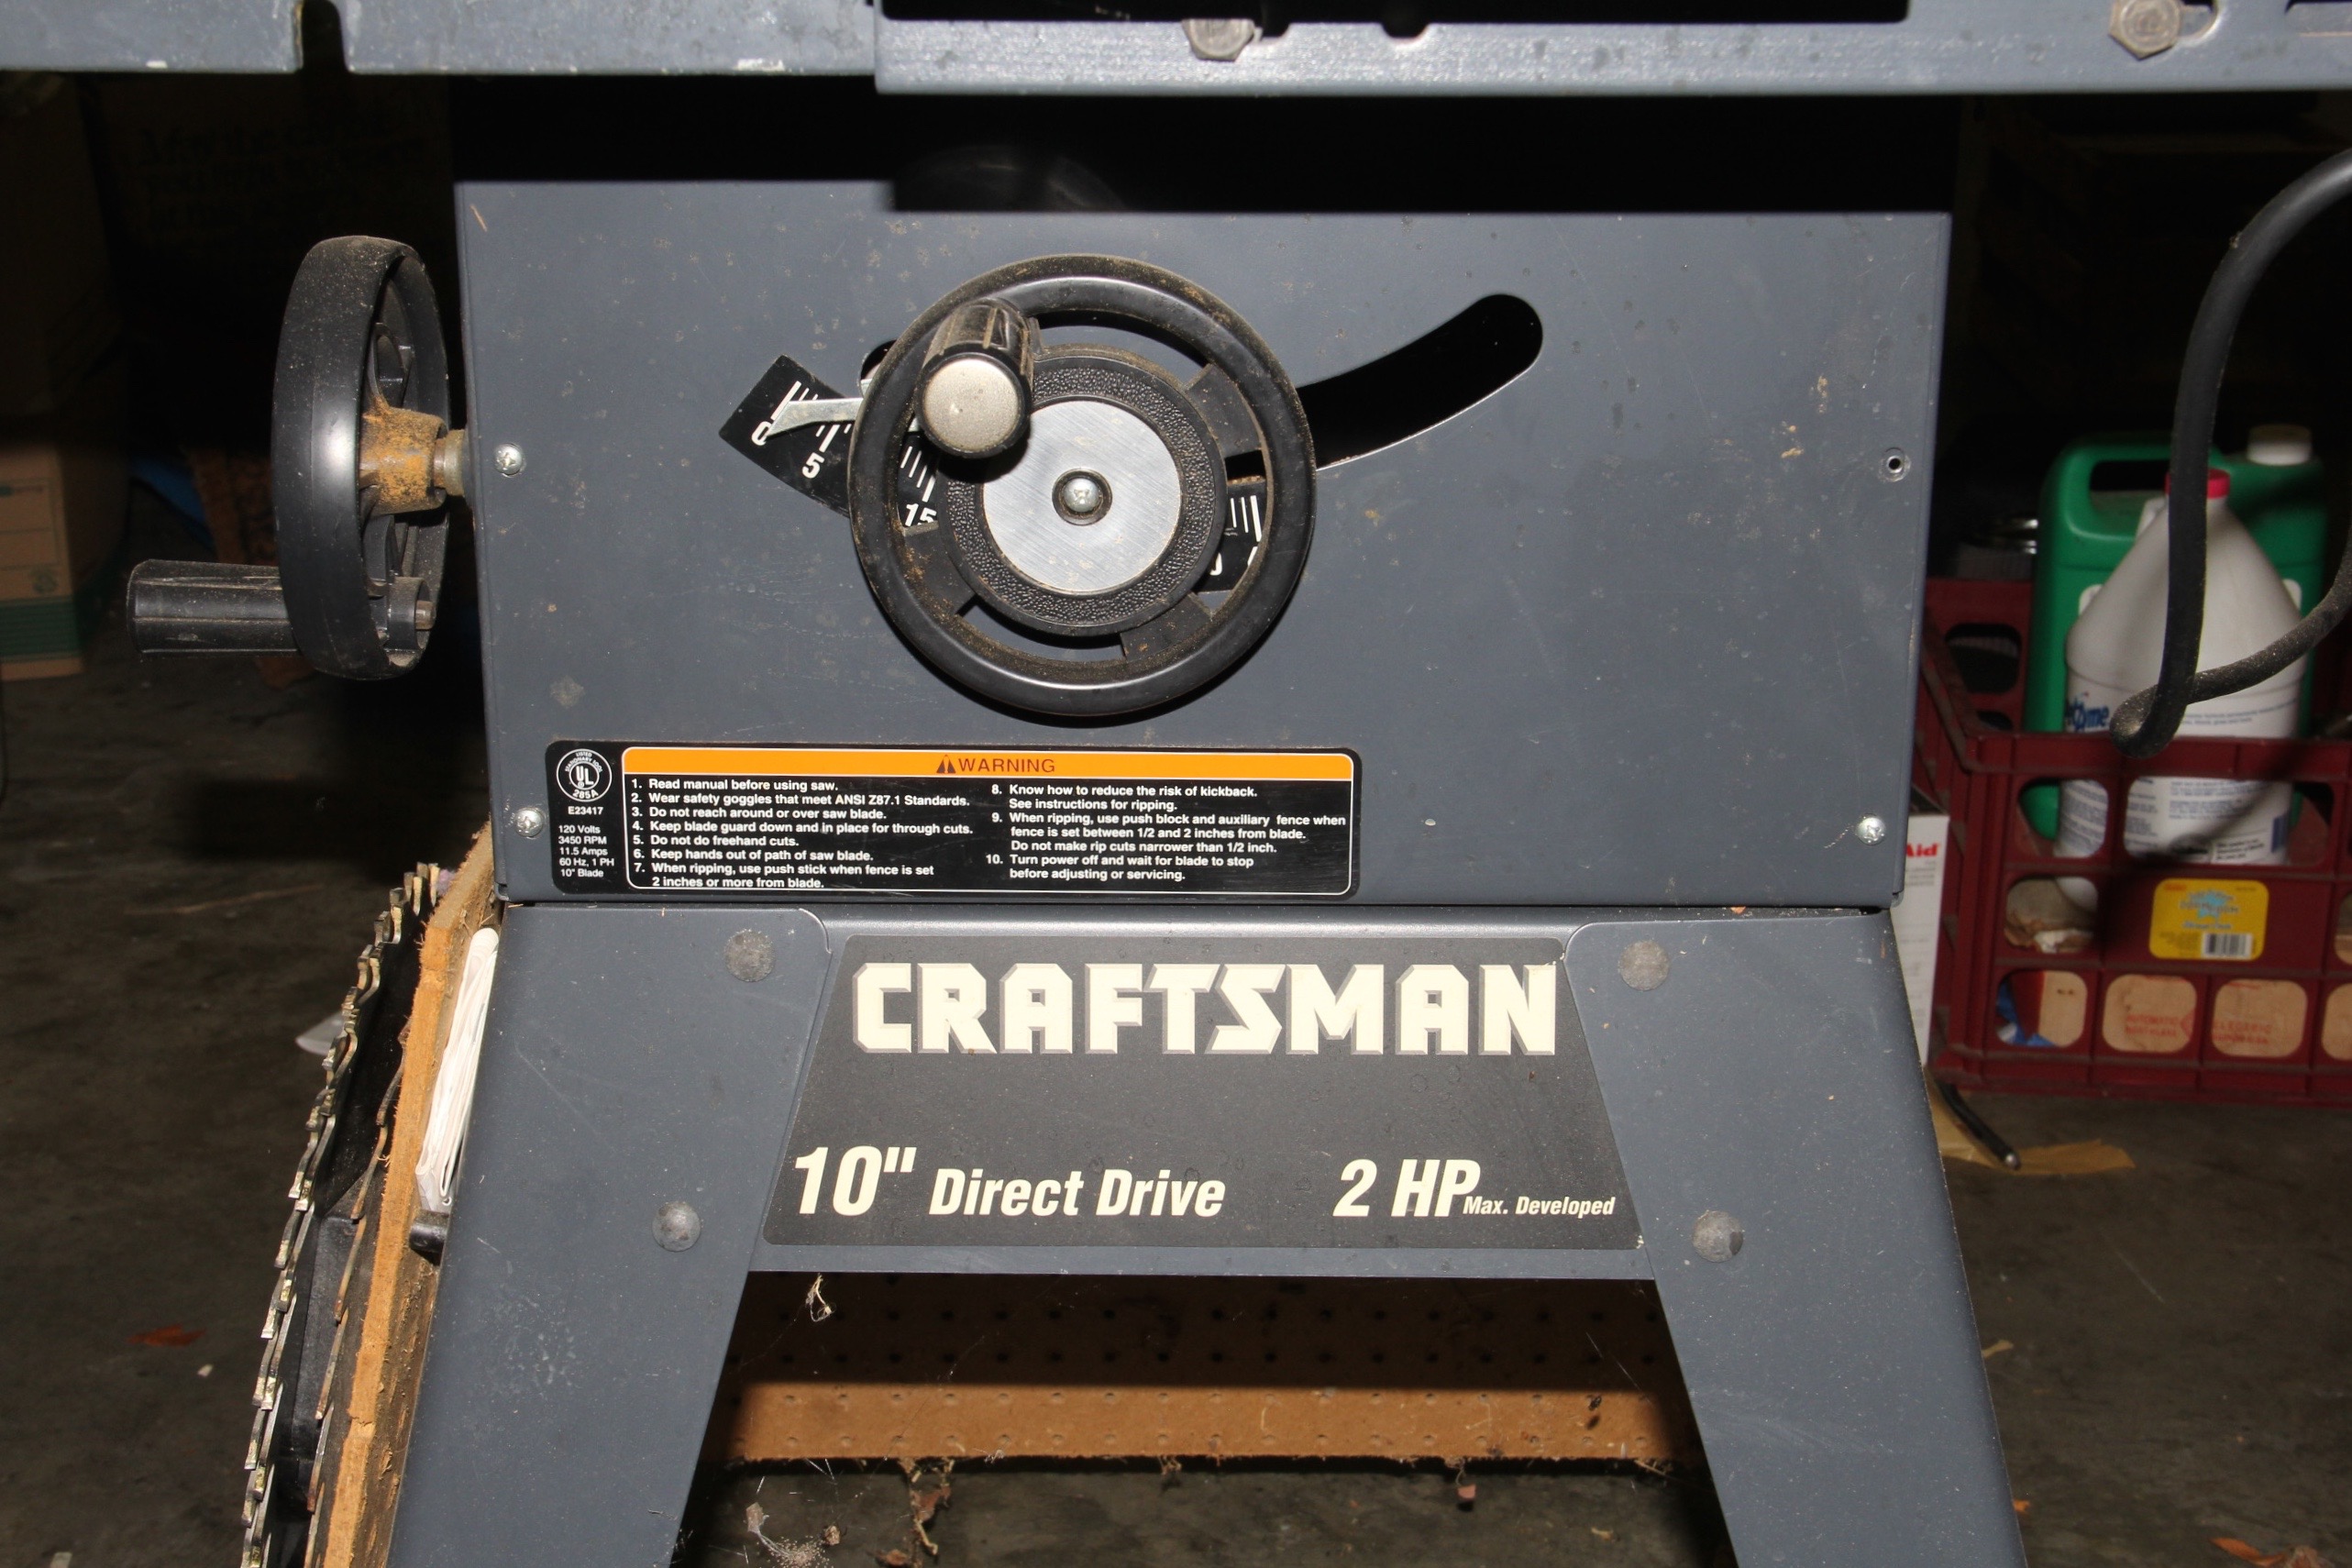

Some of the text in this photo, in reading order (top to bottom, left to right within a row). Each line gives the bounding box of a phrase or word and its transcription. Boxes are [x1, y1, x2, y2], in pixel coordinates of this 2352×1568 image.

[751, 421, 772, 447] 0
[801, 452, 825, 479] 5
[904, 502, 937, 527] 15
[592, 759, 603, 773] TOOL
[958, 757, 1055, 773] WARNING
[576, 766, 594, 786] UL
[631, 778, 838, 792] 1. Read manual before using saw.
[991, 784, 1257, 797] 8. Know how to reduce the risk of kickback.
[572, 789, 599, 800] 285A
[630, 792, 969, 806] 2. Wear safety goggles that meet ANSI Z87.1 Standards.
[568, 806, 603, 815] E23417
[1009, 798, 1177, 812] See instructions for ripping.
[631, 807, 643, 816] 3.
[648, 807, 667, 817] Do
[669, 808, 690, 817] not
[692, 807, 727, 817] reach
[729, 808, 773, 818] around
[822, 811, 847, 819] saw
[849, 809, 887, 819] blade.
[991, 812, 1346, 827] 9. When ripping, use push block and auxiliary fence when
[558, 825, 601, 834] 120 Volts
[632, 821, 973, 835] 4. Keep blade guard down and in place for through cuts.
[1010, 826, 1306, 839] fence is set between 1/2 and 2 inches from blade.
[558, 835, 607, 845] 3450 RPM
[633, 834, 799, 845] 5. Do not do freehand cuts.
[559, 847, 608, 859] 11.5 Amps
[1010, 840, 1276, 854] Do not make rip cuts narrower than 1/2 inch.
[1905, 844, 1938, 857] Aid
[558, 857, 571, 866] 60
[572, 857, 589, 867] Hz,
[599, 857, 614, 866] PH
[633, 848, 873, 862] 6. Keep hands out of path of saw blade.
[986, 855, 1254, 868] 10. Turn power off and wait for blade to stop
[560, 868, 603, 878] 10" Blade
[633, 863, 933, 876] 7. When ripping, use push stick when fence is set
[1009, 868, 1185, 882] before adjusting or servicing.
[652, 877, 824, 889] 2 inches or more from blade.
[853, 963, 1556, 1055] CRAFTSMAN
[795, 1146, 1225, 1217] 10" Direct Drive
[1333, 1159, 1616, 1219] 2 HP Max. Developed
